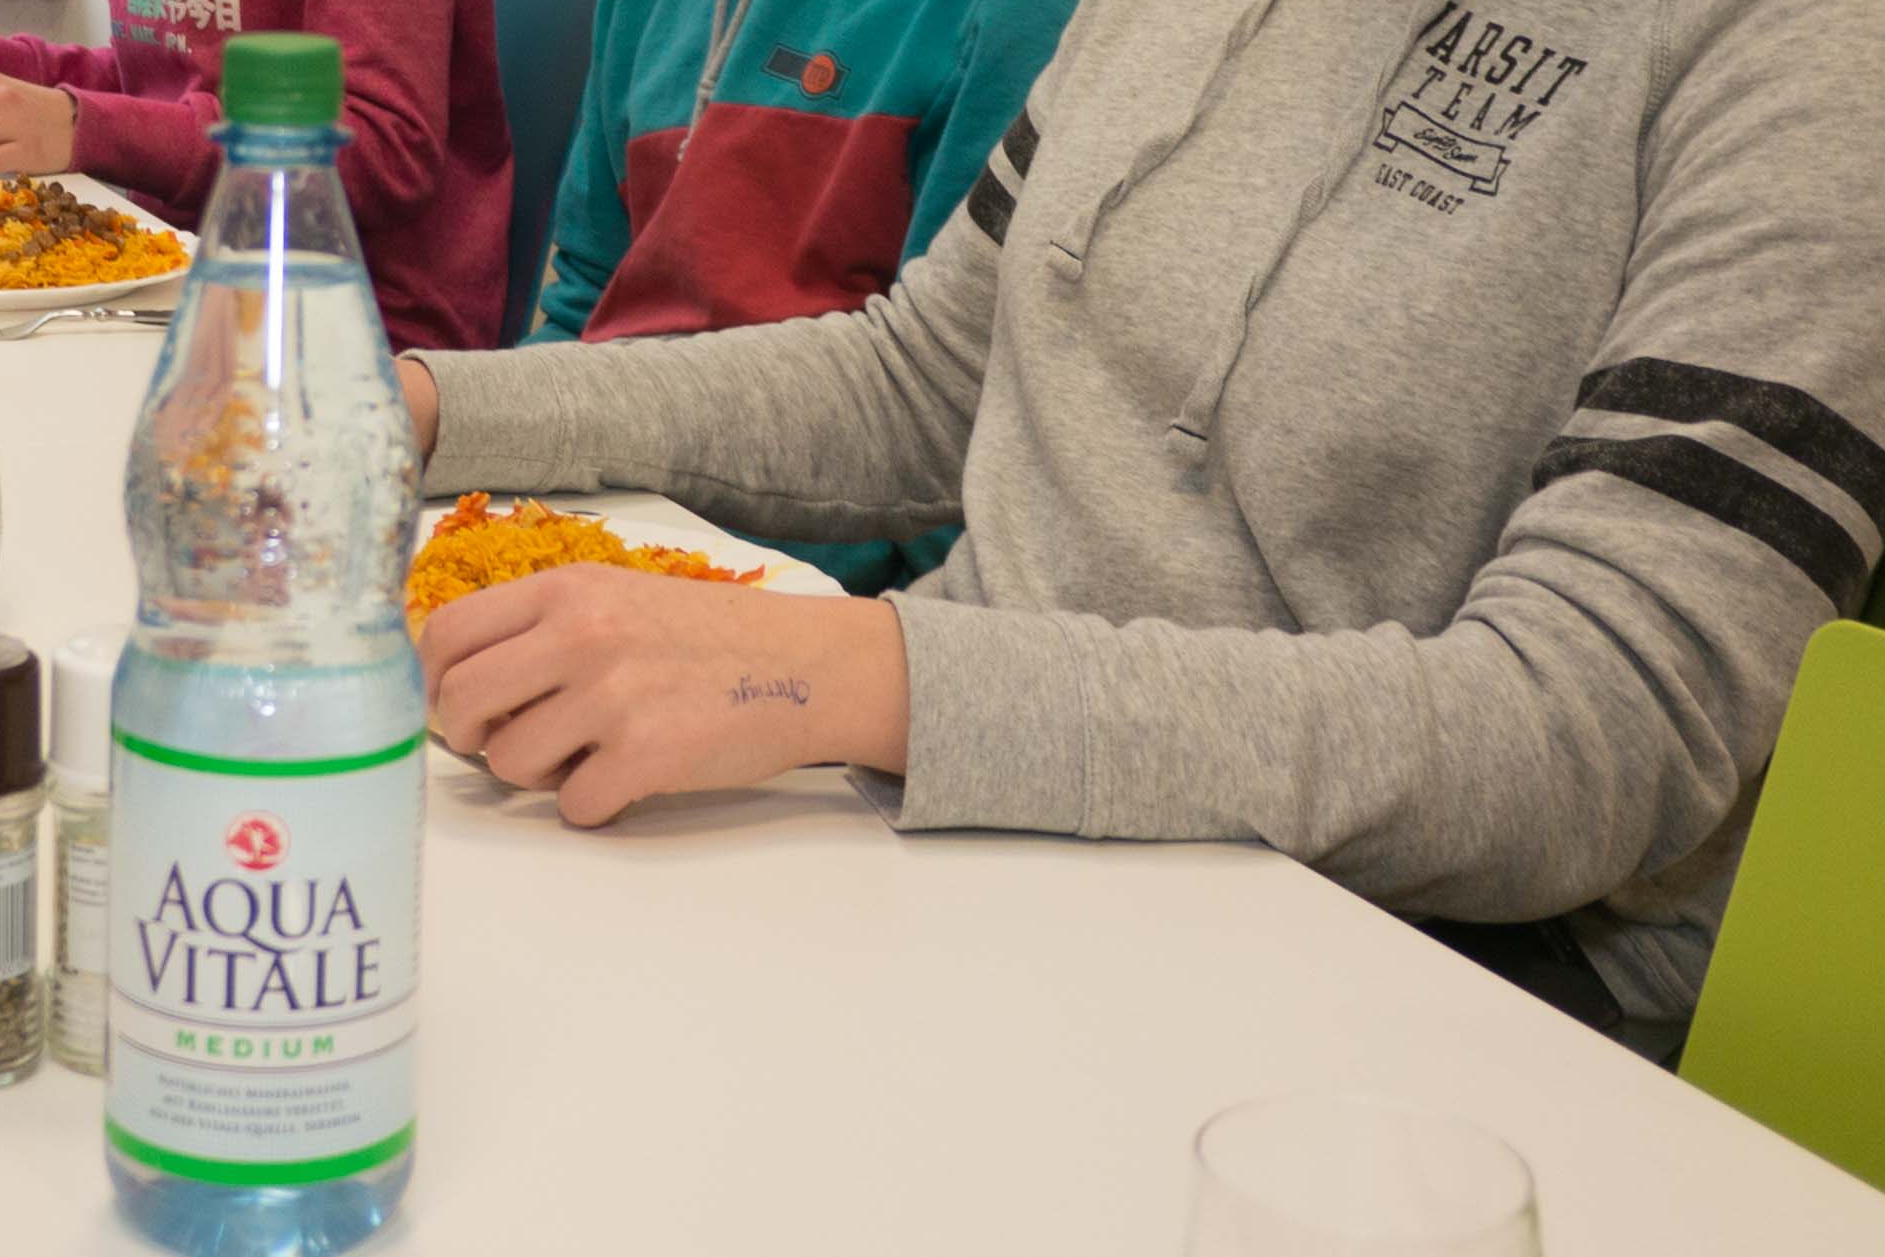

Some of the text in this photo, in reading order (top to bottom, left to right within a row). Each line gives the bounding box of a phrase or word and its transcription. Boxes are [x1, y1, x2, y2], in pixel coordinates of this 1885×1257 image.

[1411, 65, 1543, 141] TEAM
[1373, 162, 1468, 216] EAST COAST
[155, 860, 365, 957] AQUA
[135, 919, 382, 1012] VITALE
[174, 1028, 337, 1062] MEDIUM
